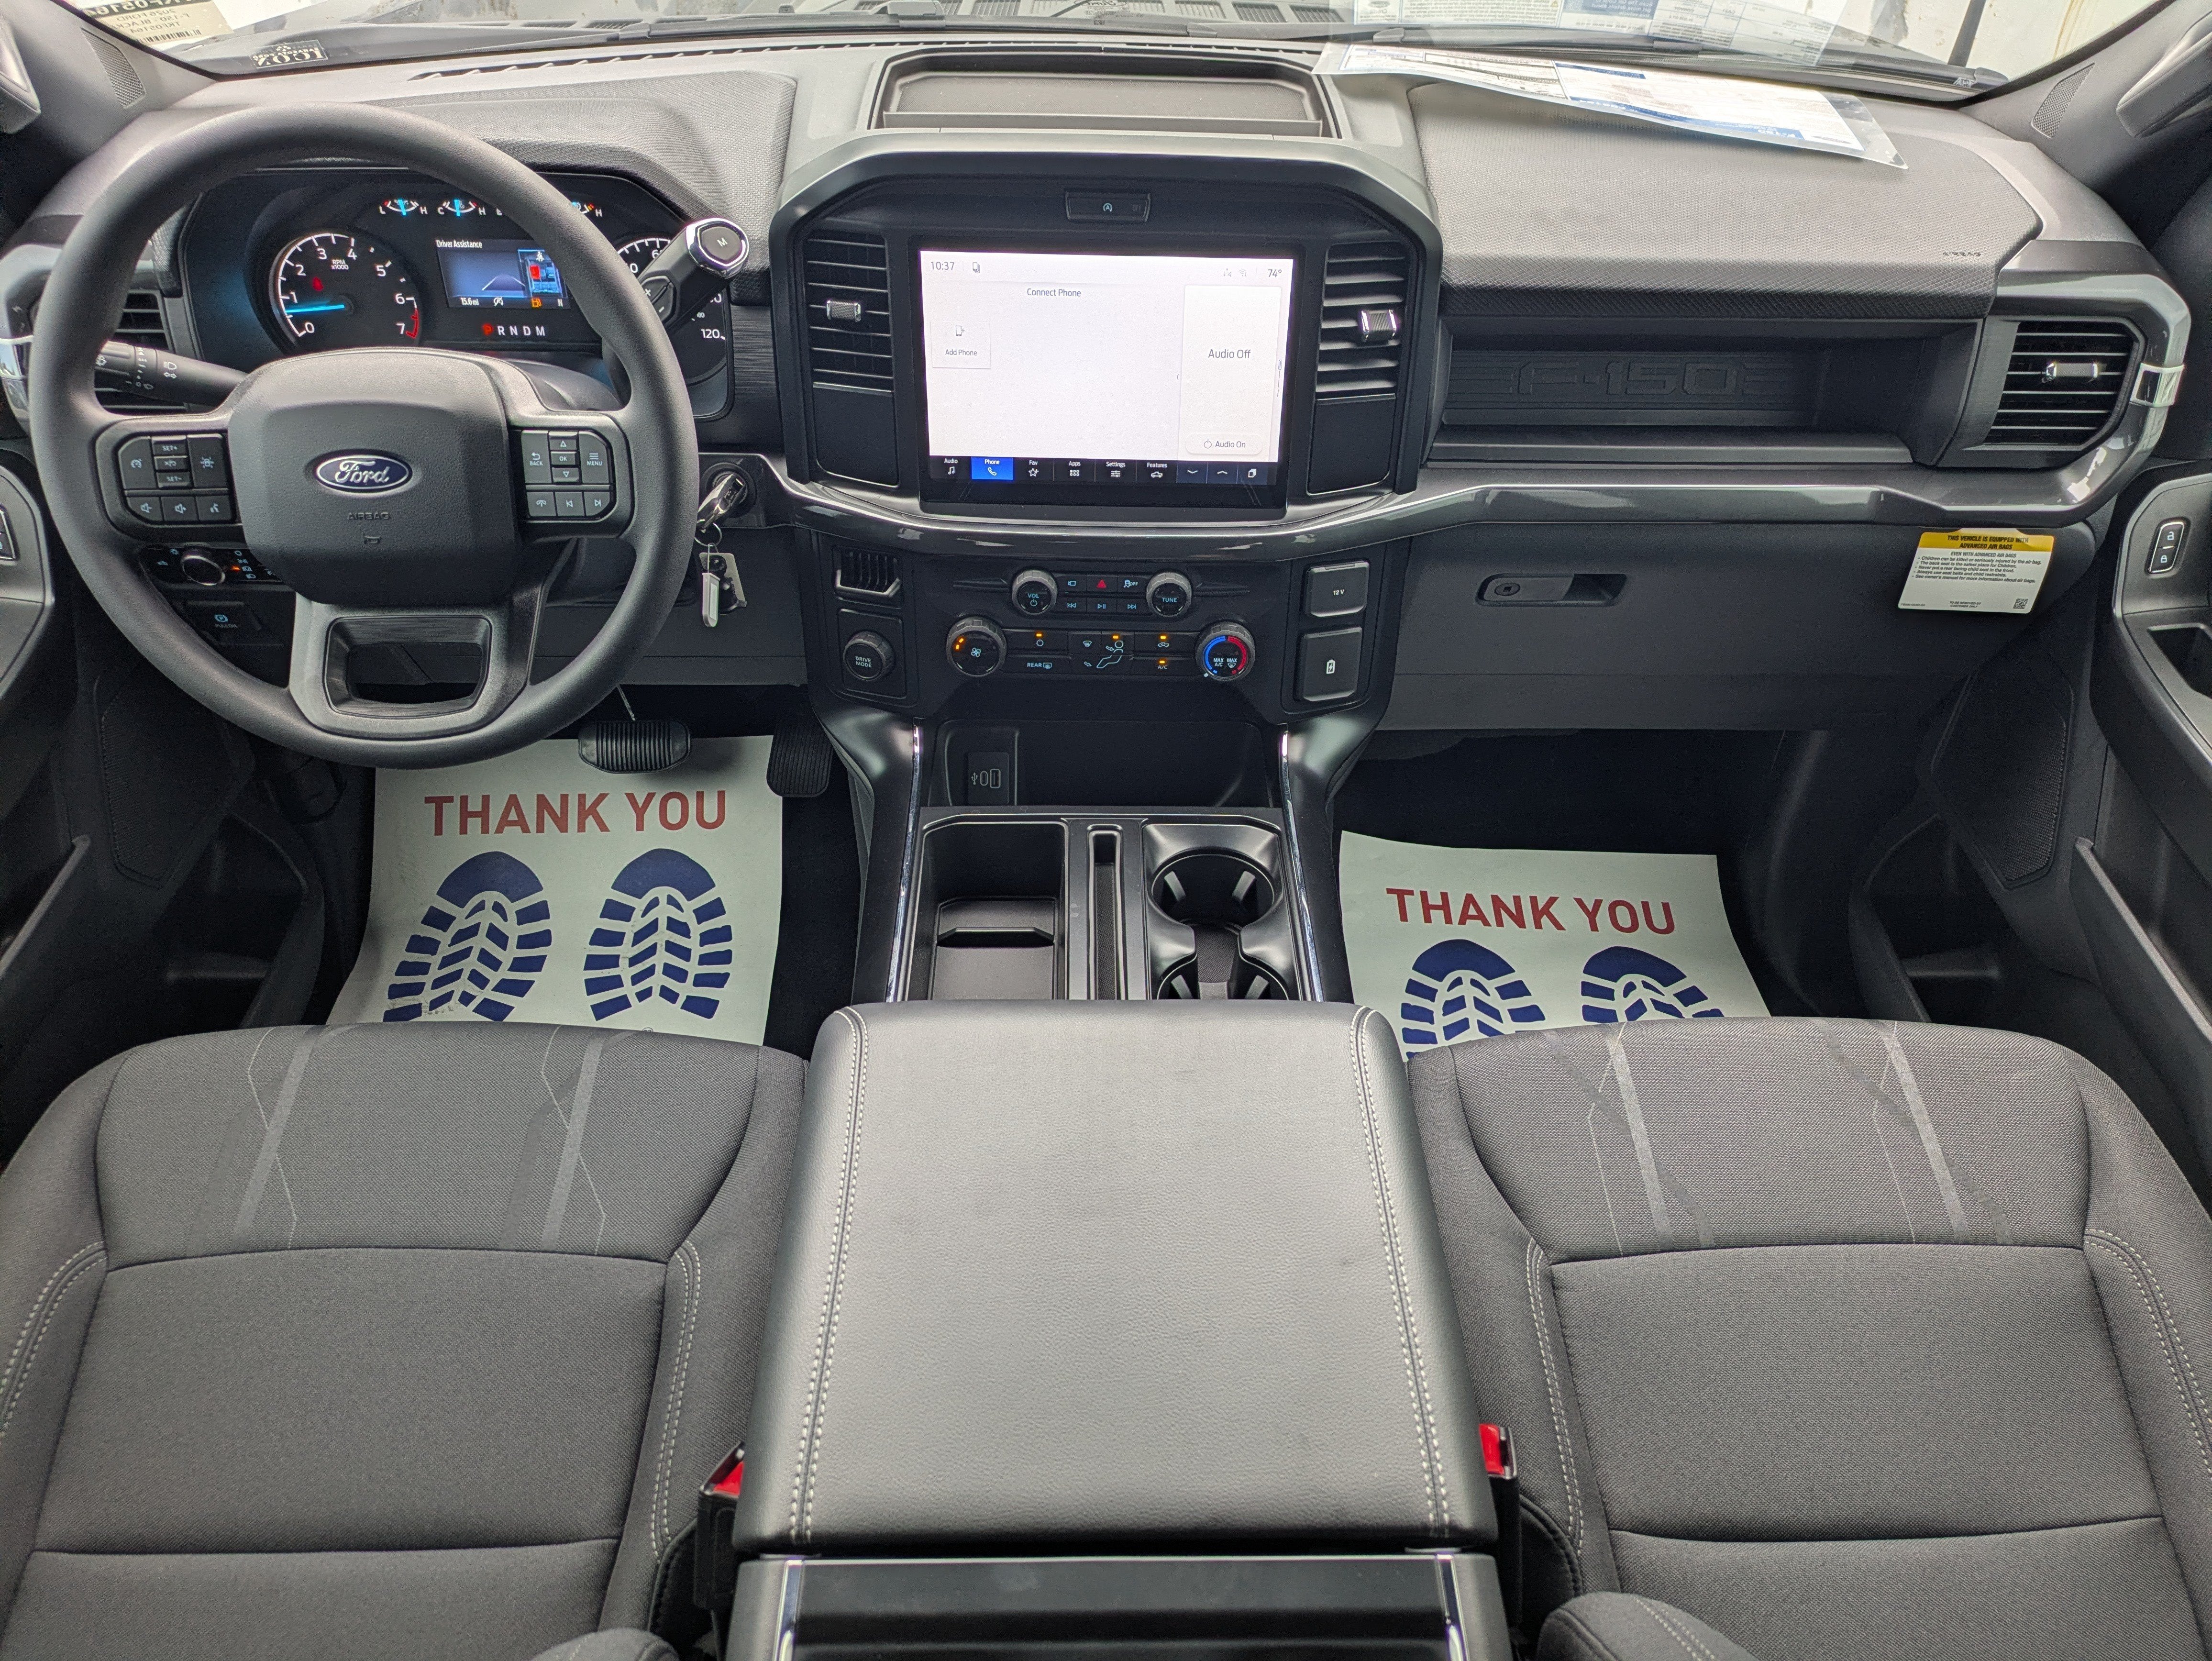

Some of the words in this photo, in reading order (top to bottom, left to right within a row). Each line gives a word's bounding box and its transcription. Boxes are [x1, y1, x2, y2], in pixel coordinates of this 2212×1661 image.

[420, 207, 428, 215] H
[437, 207, 445, 215] C
[478, 207, 486, 216] H
[595, 209, 602, 217] H
[436, 239, 453, 248] Driver
[453, 240, 483, 248] Assistance
[717, 237, 728, 248] M
[316, 247, 327, 260] 3
[347, 248, 357, 260] 4
[295, 264, 307, 276] 2
[375, 265, 387, 277] 5
[929, 261, 955, 271] 10:37
[290, 291, 298, 303] 1
[395, 292, 405, 304] 6
[1027, 288, 1056, 297] Connect
[1058, 288, 1081, 297] Phone
[557, 299, 564, 307] N
[305, 321, 315, 333] 0
[396, 322, 405, 334] 7
[483, 324, 493, 336] P
[497, 325, 506, 336] R
[509, 325, 518, 336] N
[522, 326, 531, 336] D
[535, 326, 546, 336] M
[700, 329, 720, 339] 120
[1208, 348, 1235, 359] Audio
[1237, 348, 1251, 359] Off
[1215, 440, 1235, 449] Audio
[1237, 441, 1246, 449] On
[335, 460, 390, 484] Ford
[348, 511, 391, 521] AIRBAG
[424, 792, 609, 836] THANK
[624, 790, 726, 832] YOU
[1386, 887, 1566, 931] THANK
[1572, 897, 1676, 935] YOU
